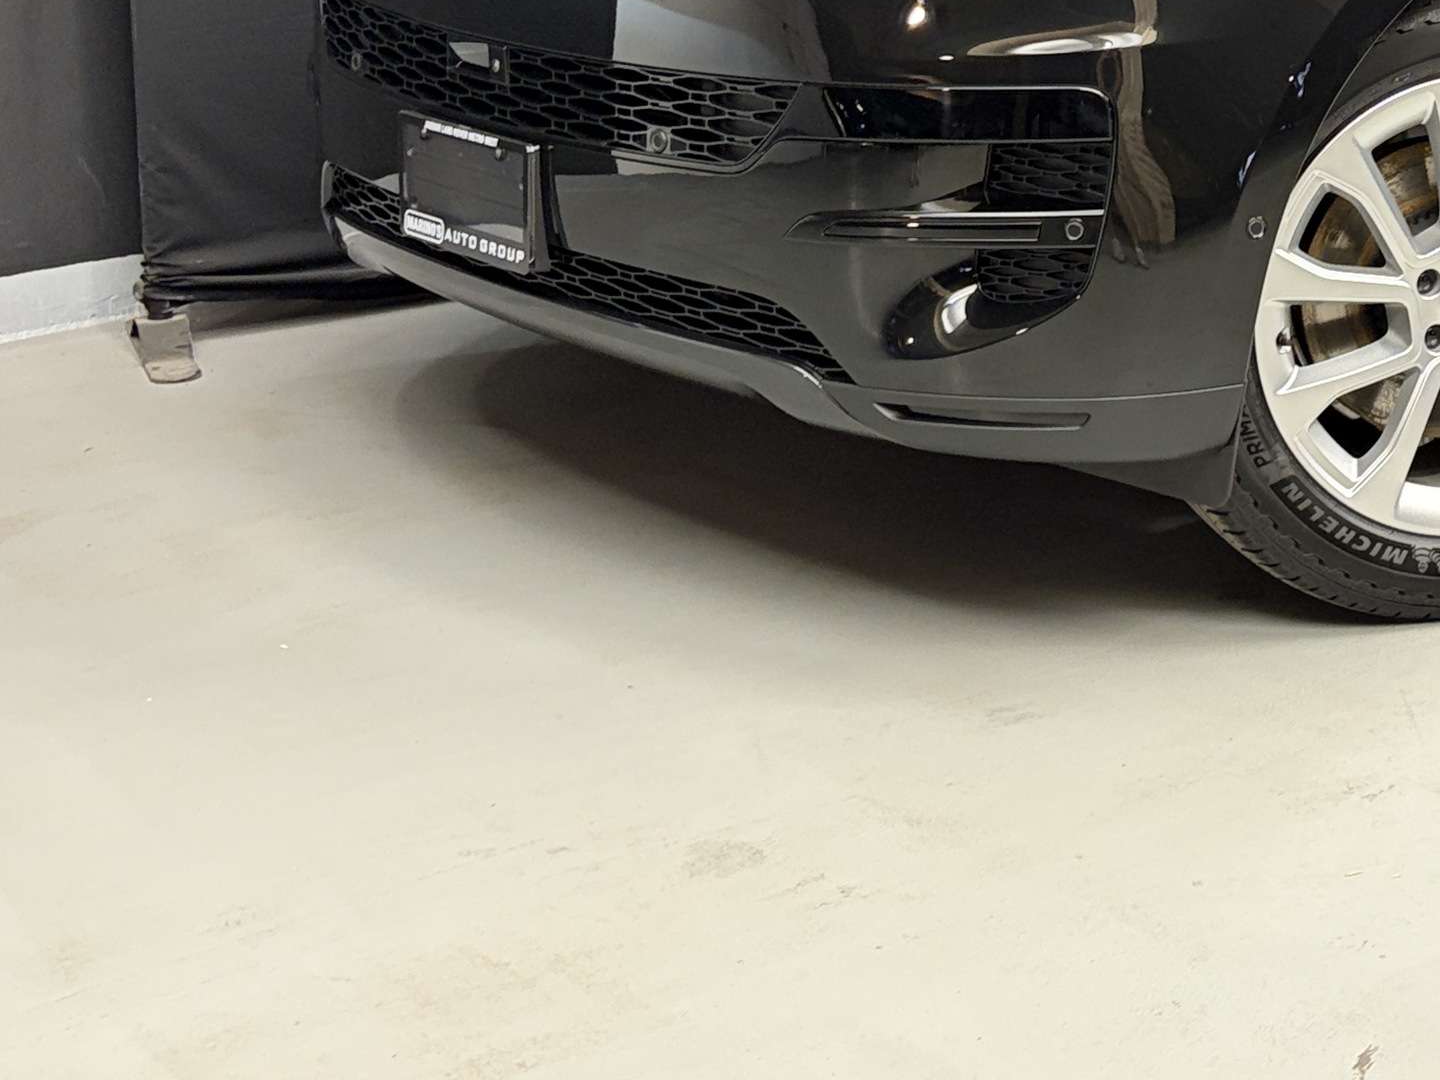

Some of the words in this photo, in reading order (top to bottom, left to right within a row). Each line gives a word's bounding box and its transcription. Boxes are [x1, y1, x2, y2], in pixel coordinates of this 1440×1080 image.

[444, 228, 478, 250] AUTO
[479, 238, 526, 264] GROUP
[1281, 481, 1408, 566] MICHELIN
